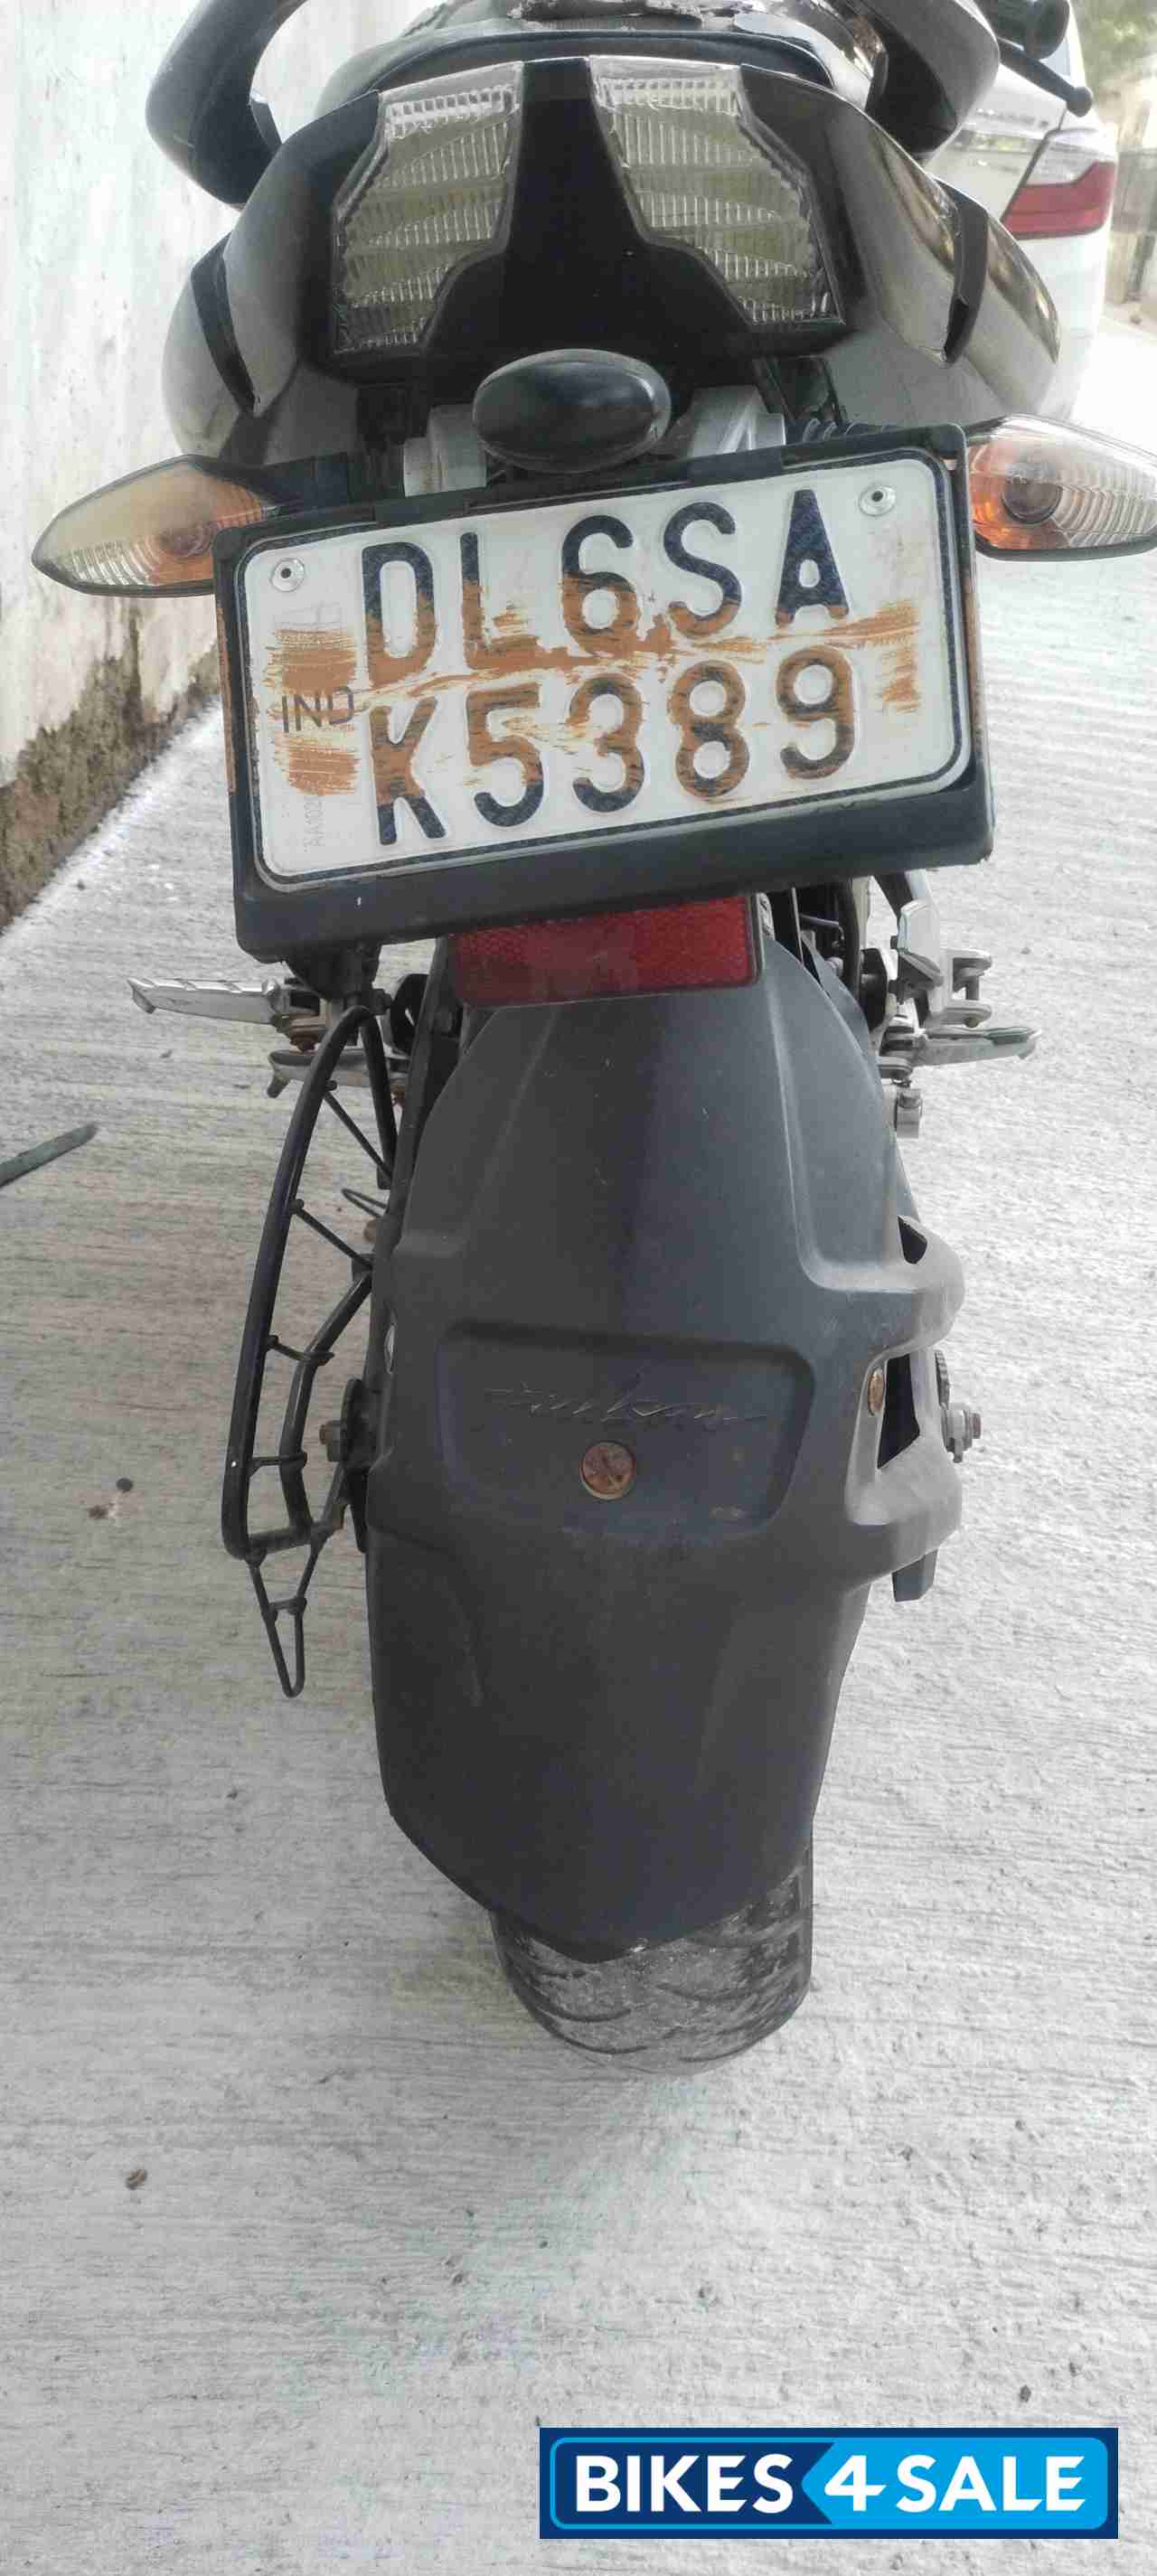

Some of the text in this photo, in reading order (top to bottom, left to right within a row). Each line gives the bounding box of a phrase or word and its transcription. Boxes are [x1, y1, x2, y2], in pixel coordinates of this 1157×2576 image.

[362, 488, 850, 690] DL6SA
[281, 685, 356, 734] IND
[367, 643, 857, 847] K5389
